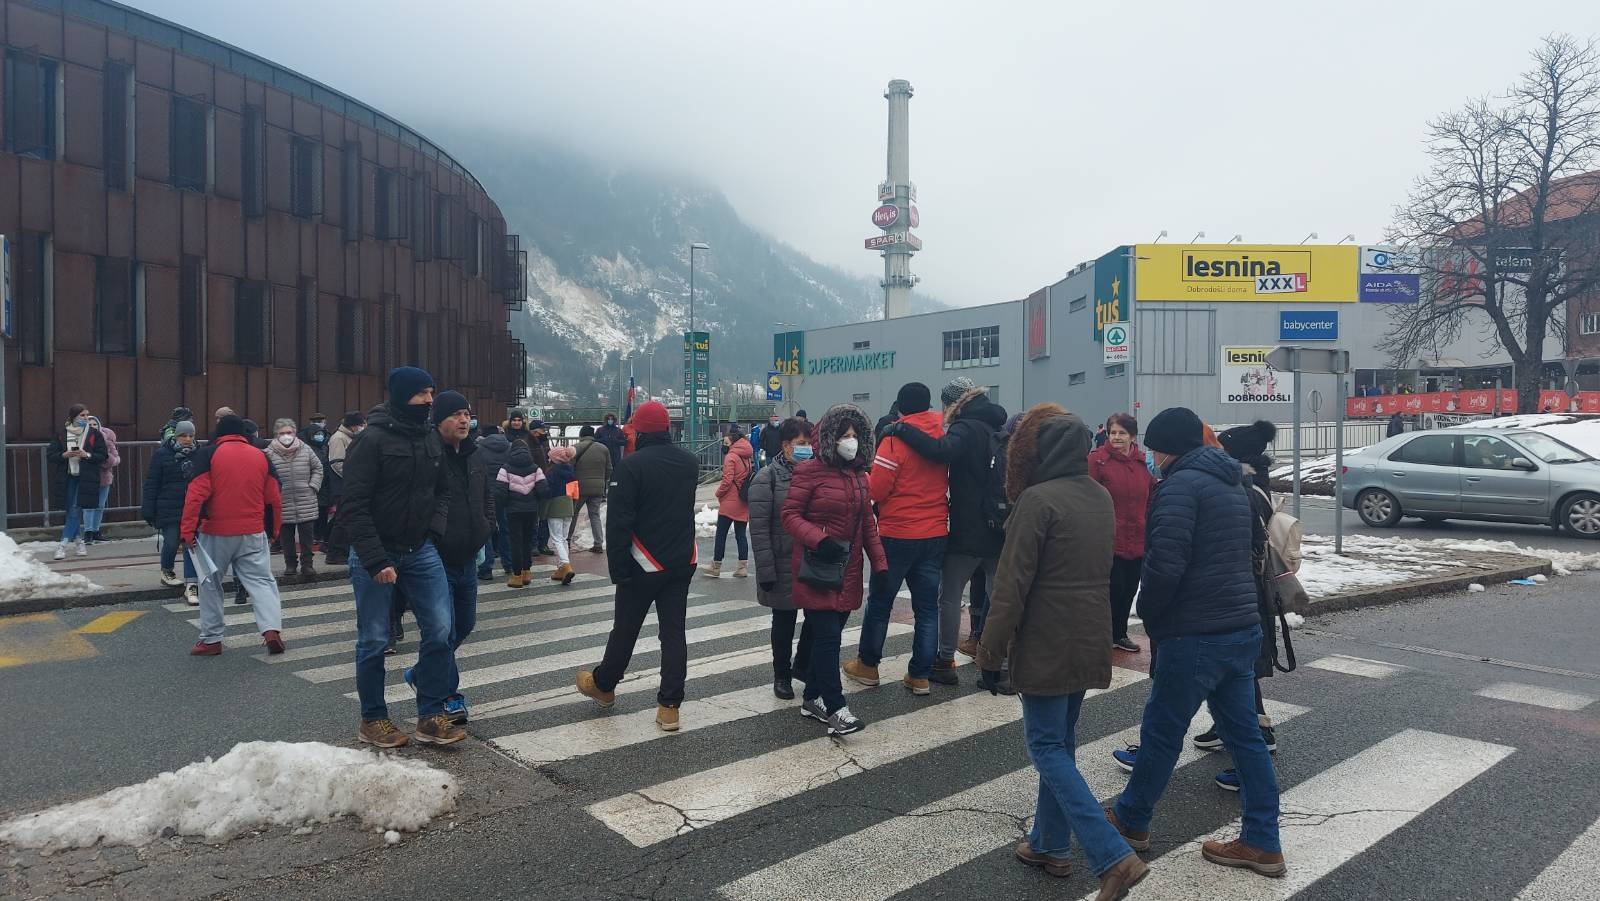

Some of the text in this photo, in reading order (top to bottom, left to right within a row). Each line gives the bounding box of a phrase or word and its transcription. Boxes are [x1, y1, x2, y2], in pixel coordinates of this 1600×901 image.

[870, 235, 895, 247] SPAR
[1186, 255, 1281, 278] lesnina
[1187, 285, 1226, 293] Dobrodošli
[1258, 276, 1306, 291] XXXL
[1283, 319, 1334, 331] babycenter
[808, 350, 897, 376] SUPERMARKET
[1227, 351, 1266, 363] lesni
[1228, 392, 1291, 402] DOBRODOŠLI
